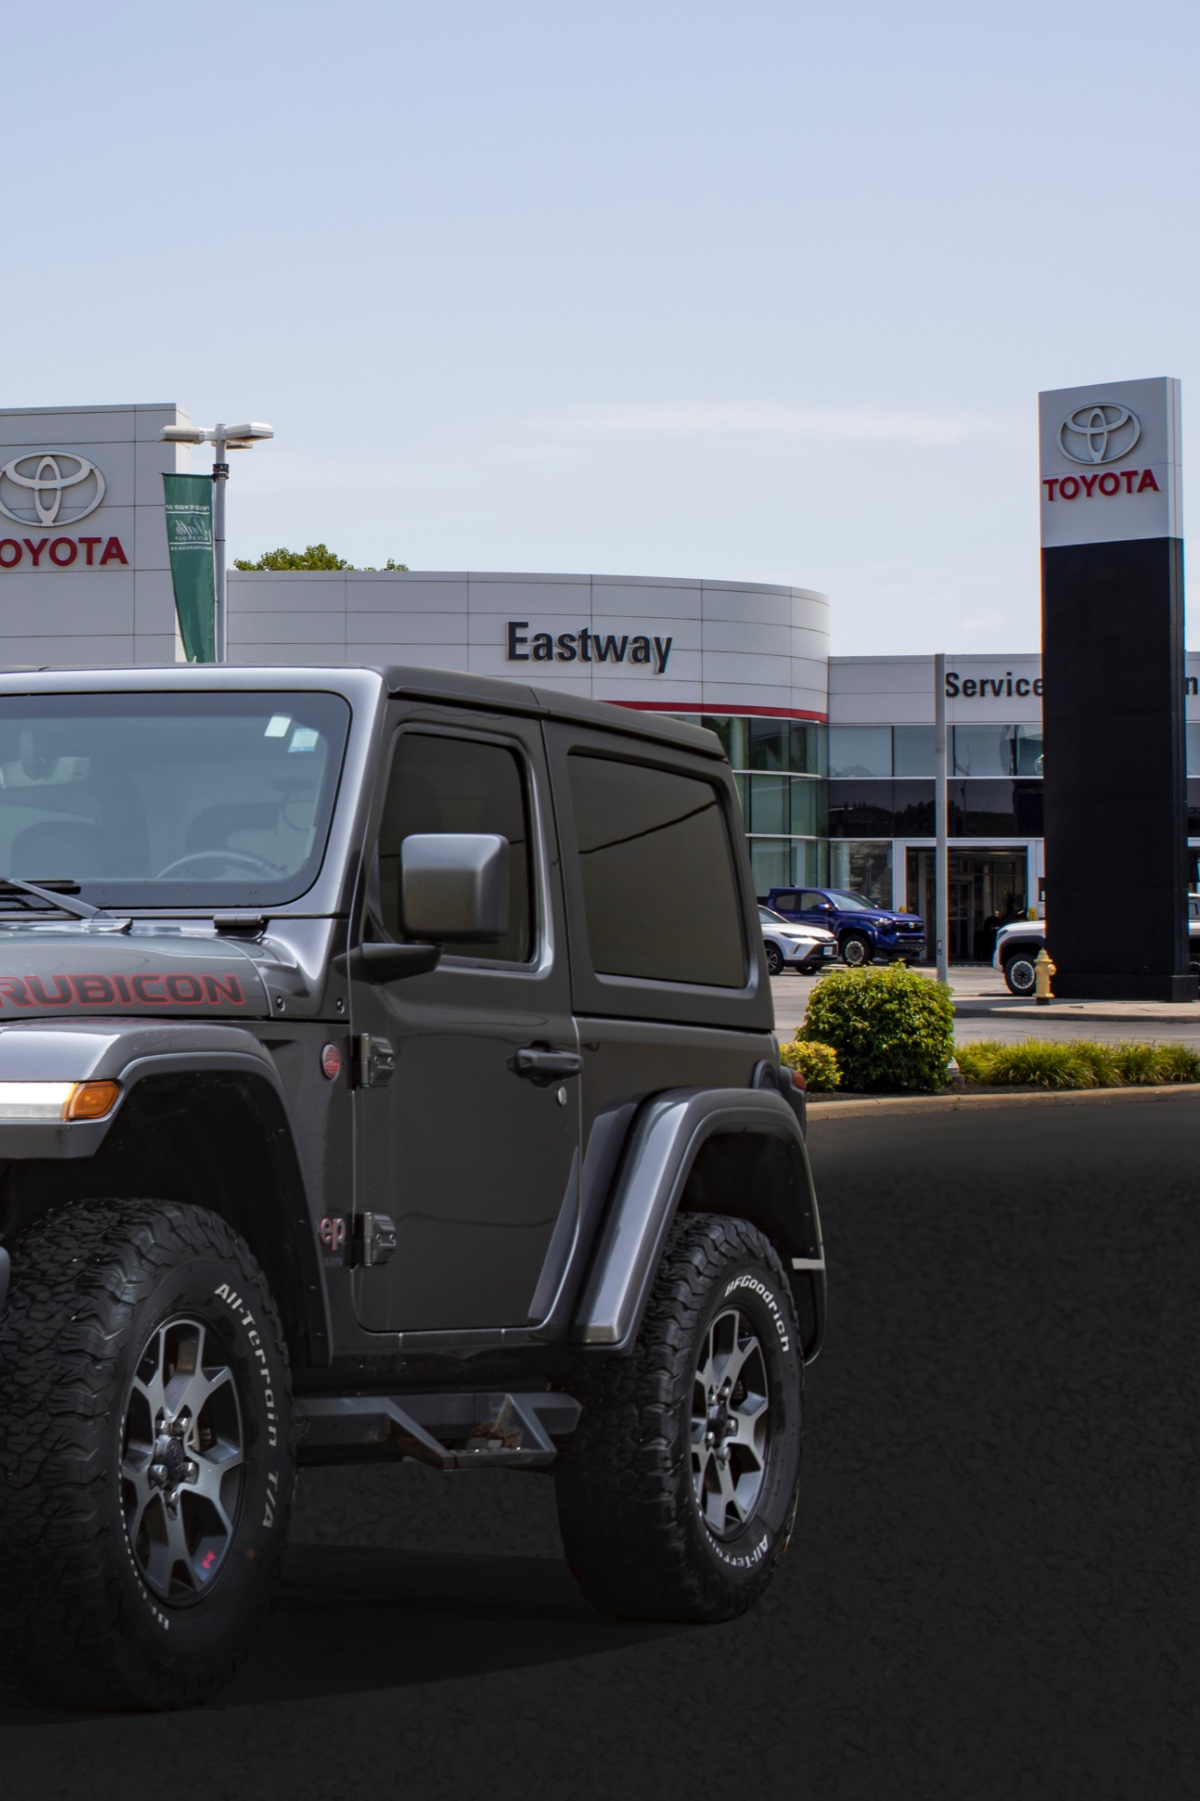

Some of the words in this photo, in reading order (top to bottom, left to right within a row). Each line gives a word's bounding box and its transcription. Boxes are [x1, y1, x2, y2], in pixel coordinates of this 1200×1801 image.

[1042, 469, 1160, 501] TOYOTA
[506, 621, 673, 674] Eastway
[945, 672, 1044, 698] Service
[319, 1218, 346, 1252] ep
[724, 1275, 789, 1352] BFGoodrich
[214, 1283, 279, 1447] All-Terrain
[262, 1470, 280, 1528] T/A
